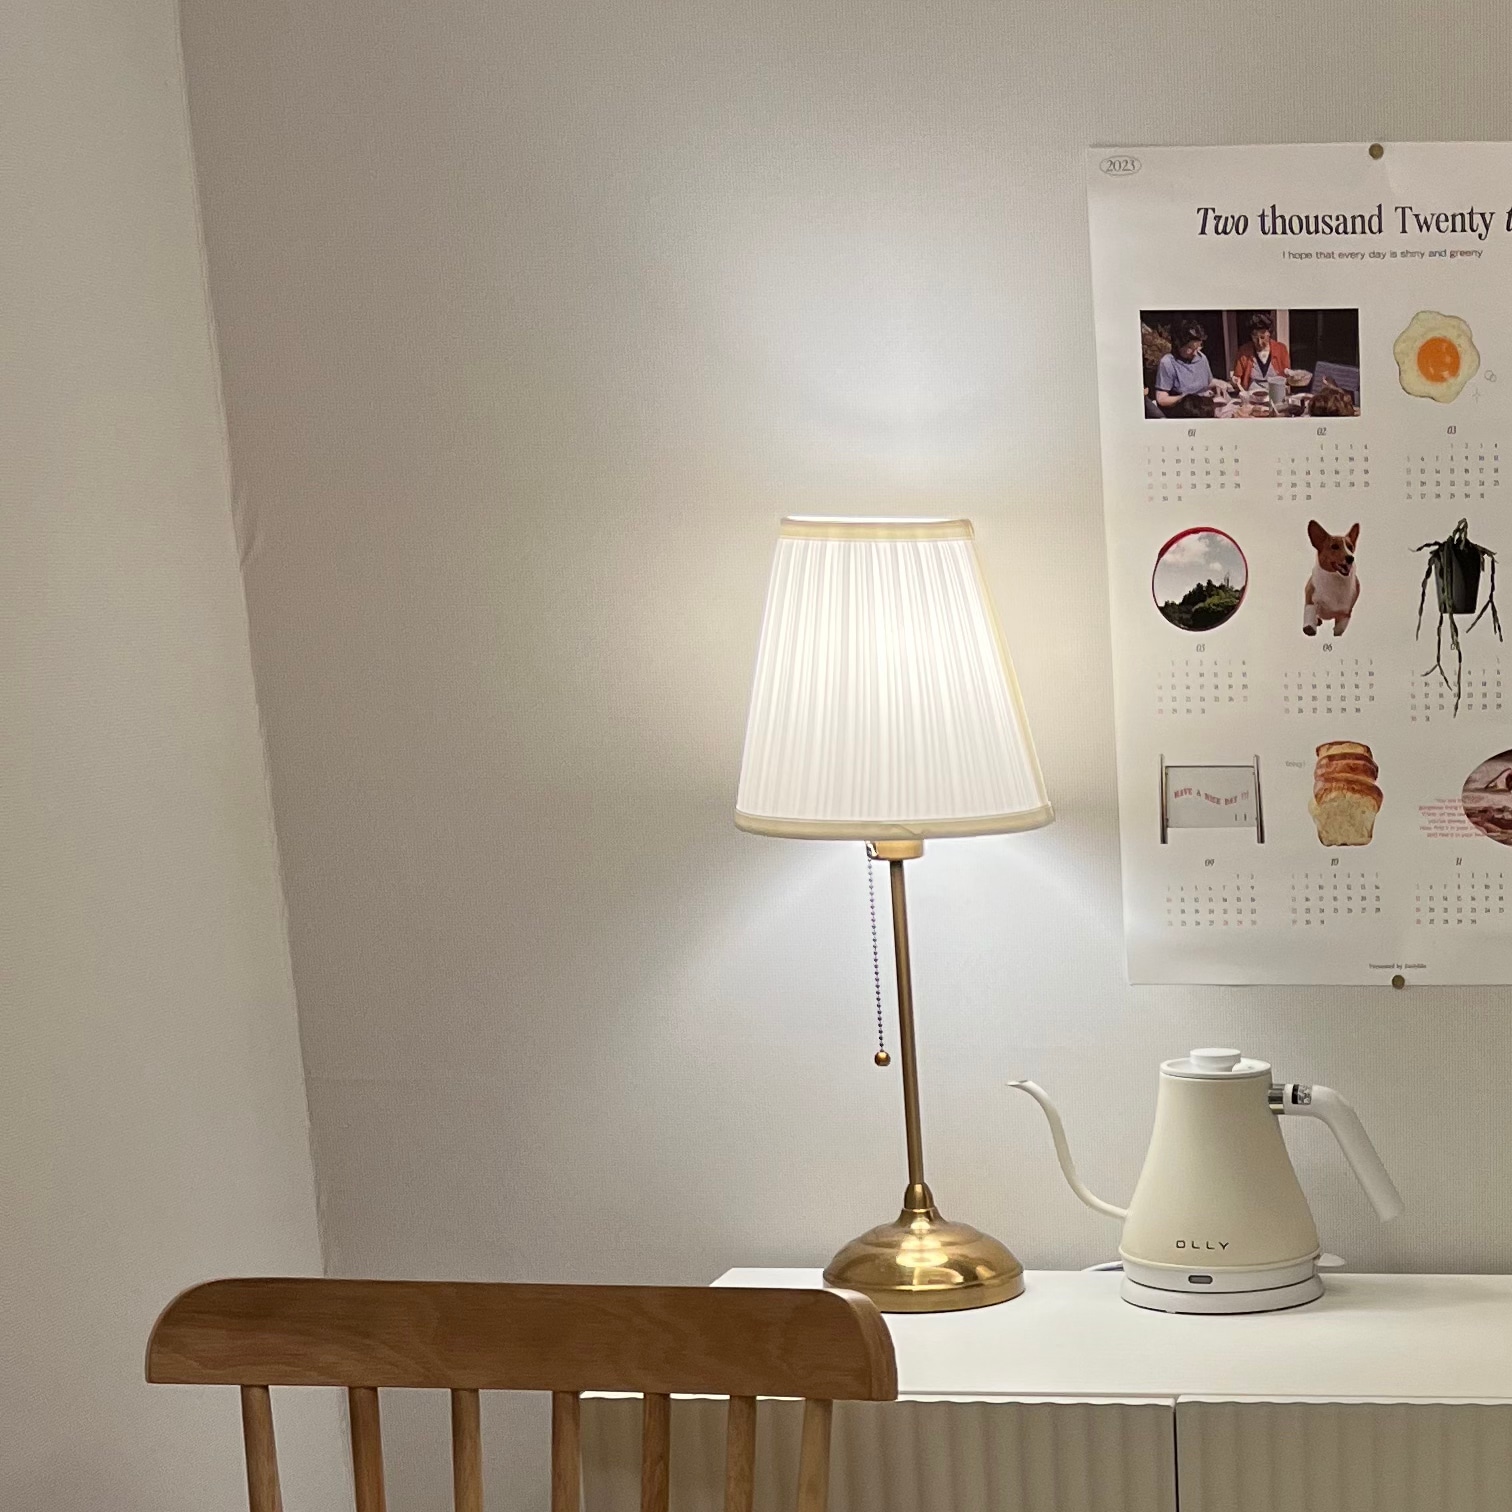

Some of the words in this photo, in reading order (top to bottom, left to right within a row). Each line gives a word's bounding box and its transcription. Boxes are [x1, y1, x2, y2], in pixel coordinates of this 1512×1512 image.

[1106, 160, 1135, 172] 2023
[1197, 207, 1249, 236] Two
[1257, 203, 1384, 236] thousand
[1394, 205, 1496, 241] Twenty
[1288, 250, 1313, 261] hope
[1316, 250, 1336, 260] that
[1338, 251, 1365, 261] every
[1368, 250, 1387, 260] day
[1390, 250, 1398, 258] is
[1400, 249, 1425, 259] shiny
[1429, 248, 1447, 258] and
[1450, 249, 1483, 259] greeny
[1174, 788, 1193, 799] HAVE
[1204, 793, 1221, 805] NICE
[1225, 796, 1238, 806] DAY
[1175, 1240, 1230, 1250] OLLY
